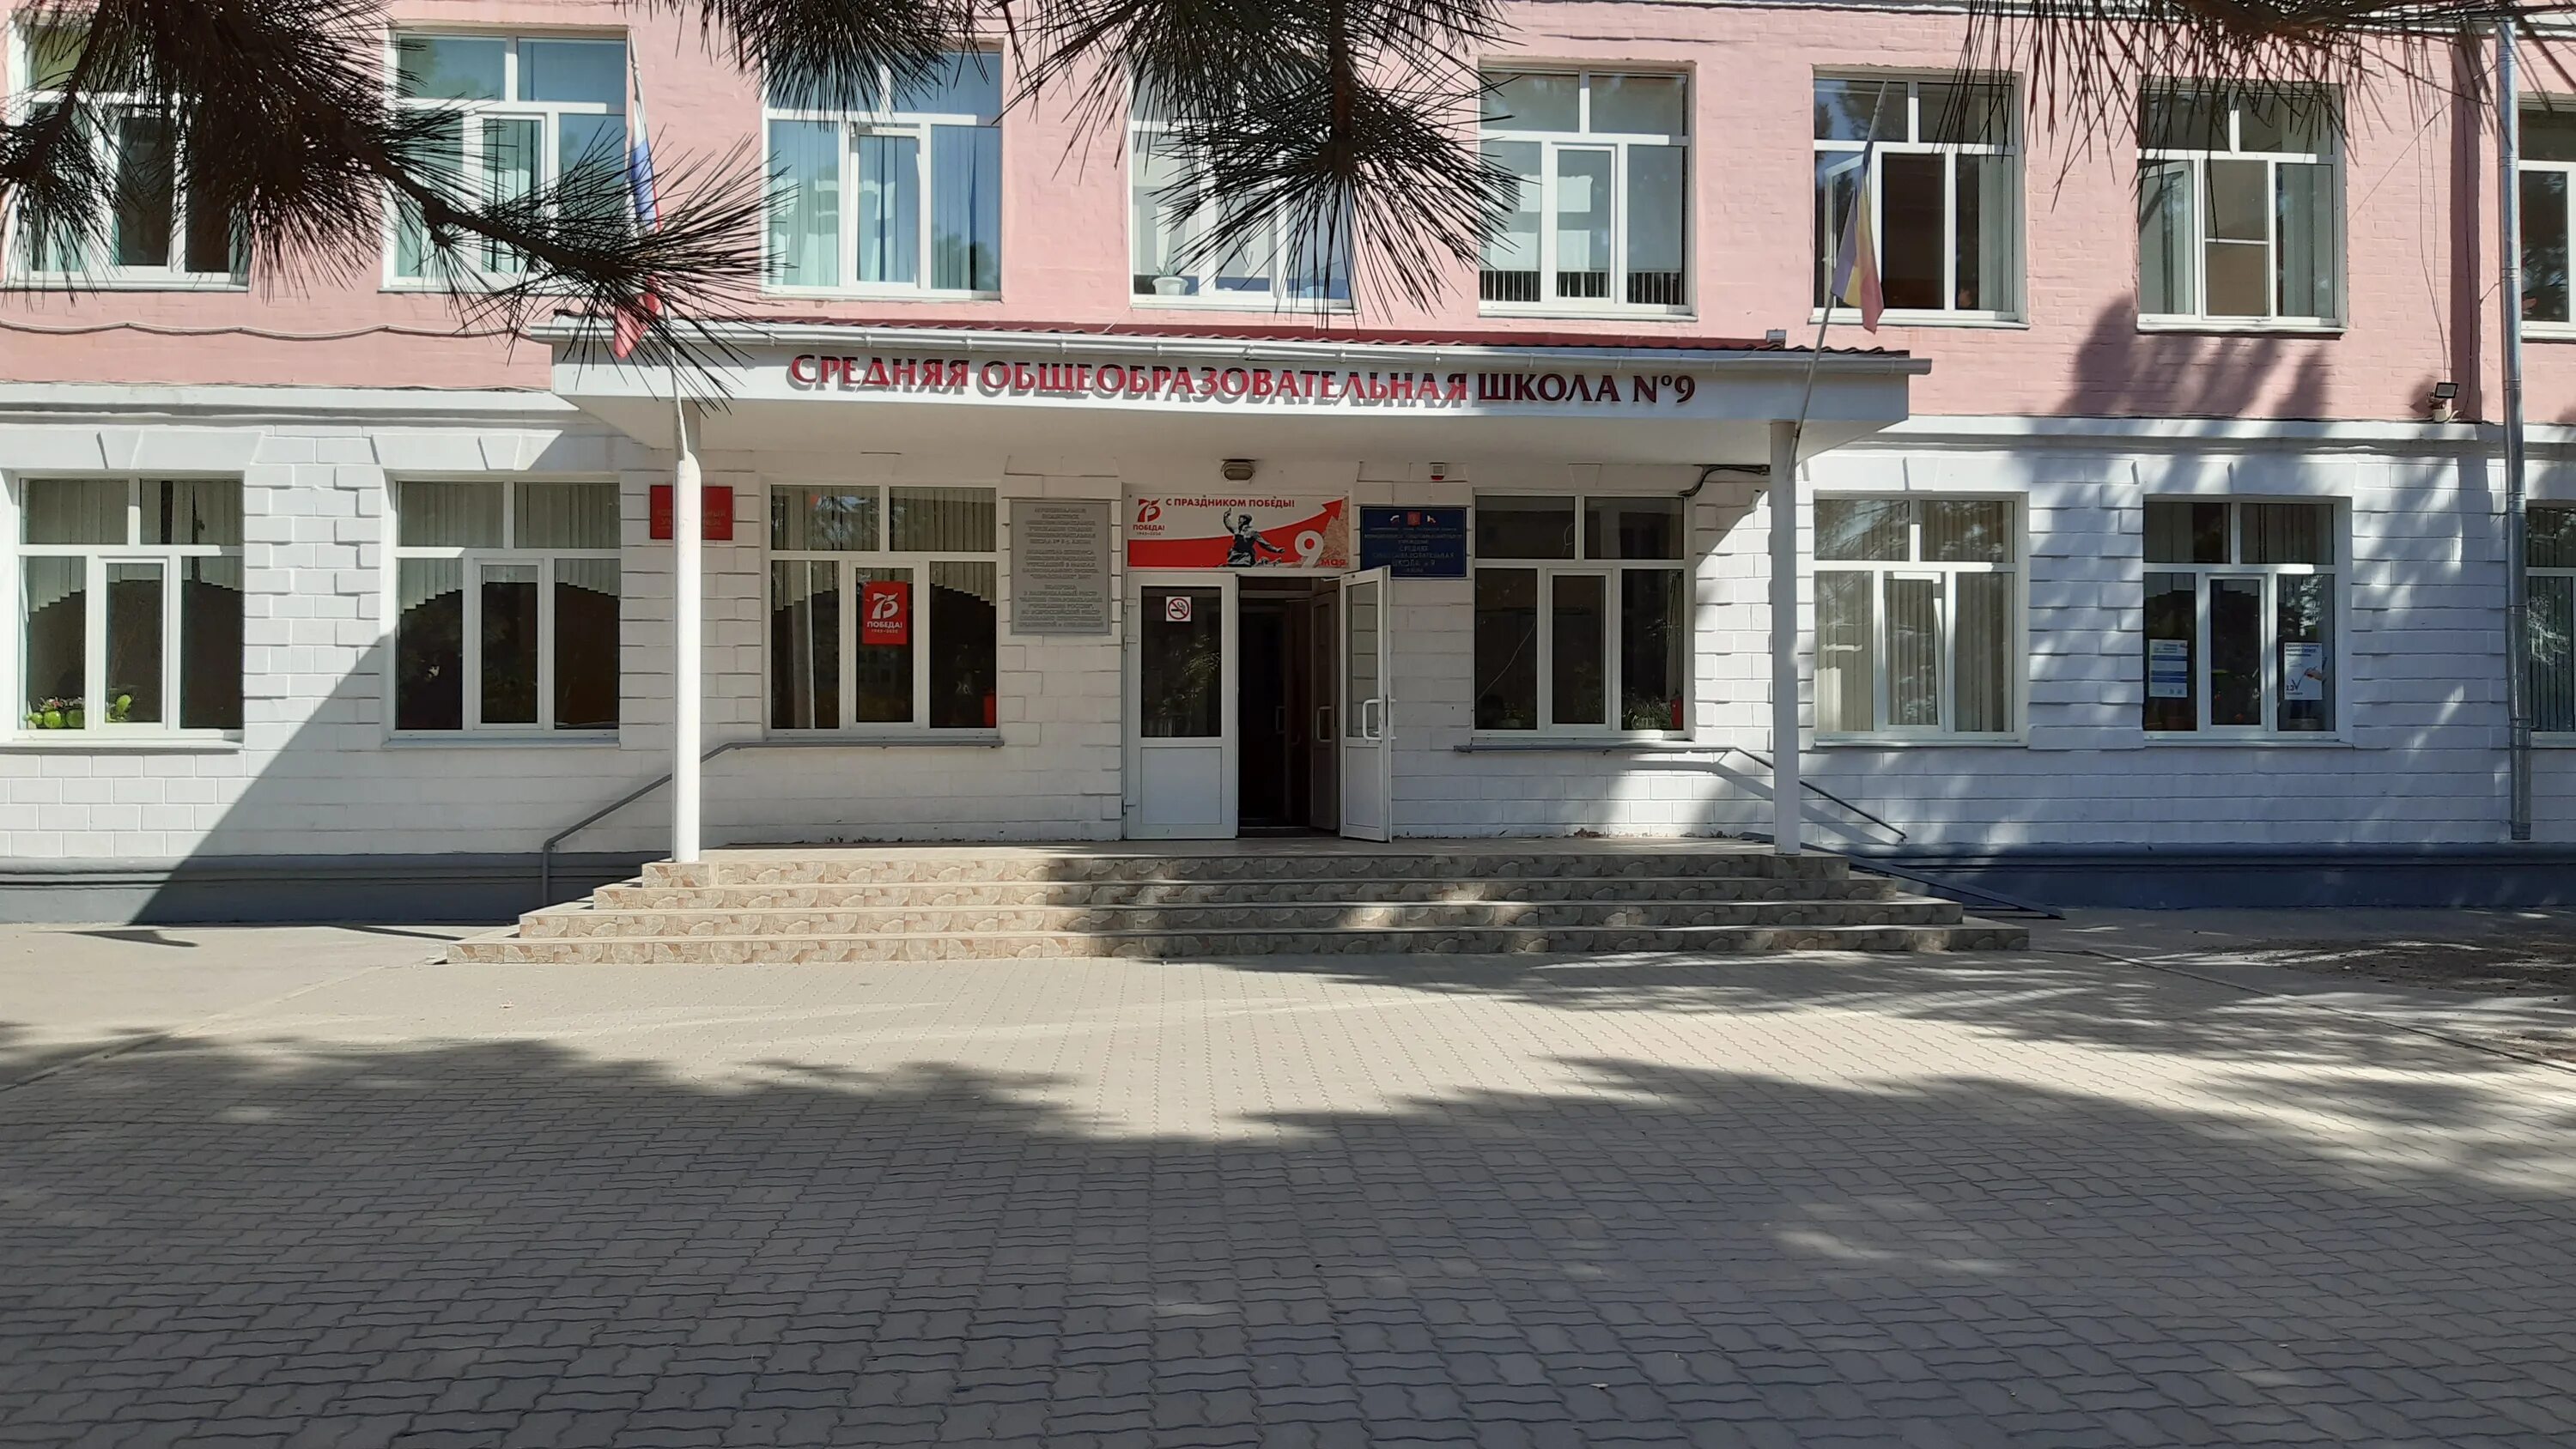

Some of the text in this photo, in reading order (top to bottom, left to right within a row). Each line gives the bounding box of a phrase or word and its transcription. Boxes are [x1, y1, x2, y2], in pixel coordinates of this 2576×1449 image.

[790, 354, 969, 388] СРЕДНЯЯ
[981, 360, 1467, 401] ОБЩЕОБРАЗОВАТЕЛЬНАЯ
[1478, 372, 1621, 403] ШКОЛА
[1137, 498, 1161, 522] 75
[1165, 498, 1296, 508] С ПРАЗДНИКОМ ПОБЕДЫ!
[1294, 530, 1324, 568] 9
[872, 592, 899, 619] 75
